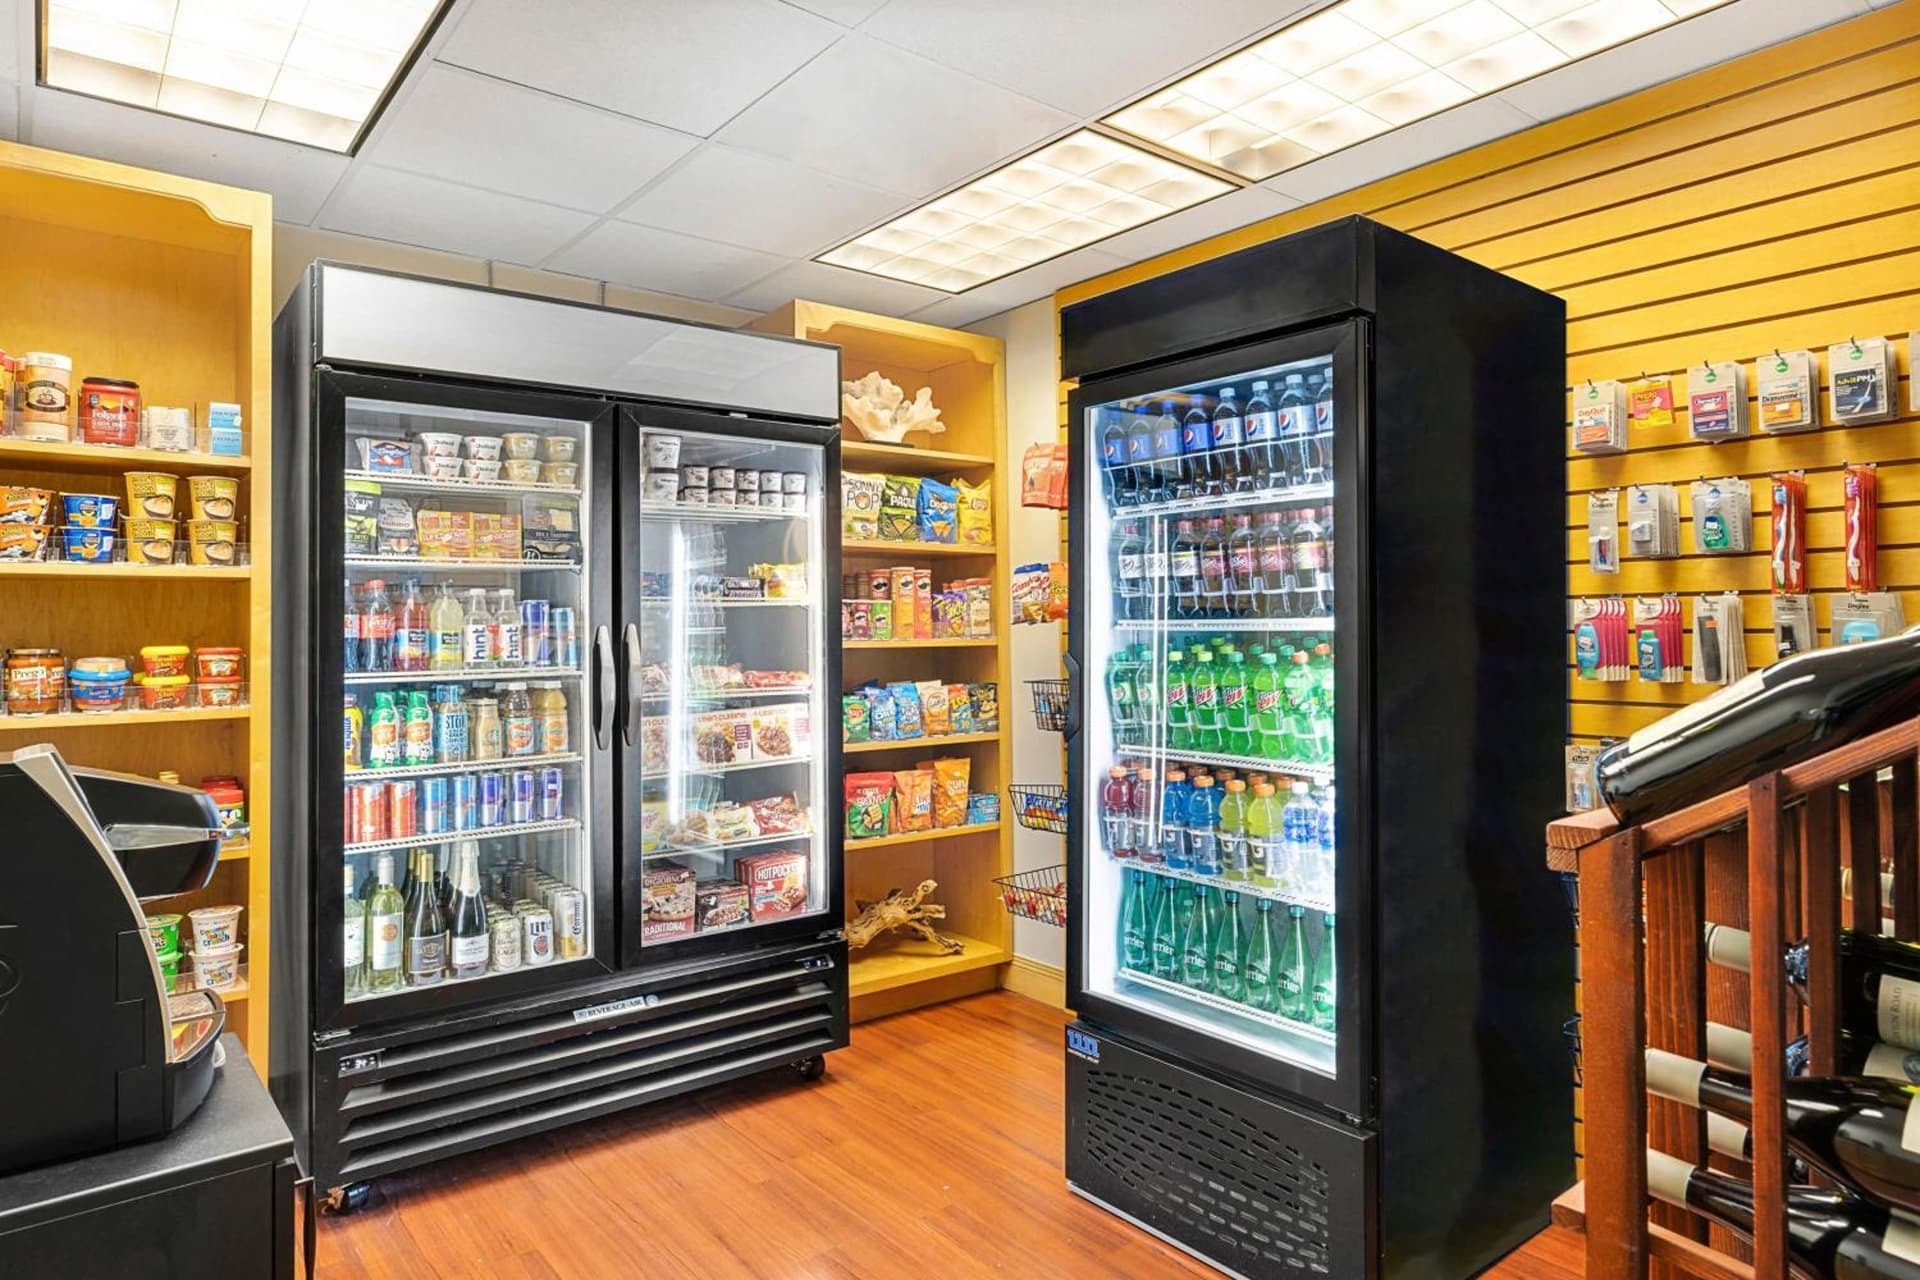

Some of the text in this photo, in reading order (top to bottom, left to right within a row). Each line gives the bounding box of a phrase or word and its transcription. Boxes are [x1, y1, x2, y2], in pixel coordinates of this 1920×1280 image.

[847, 490, 880, 510] POP
[473, 627, 486, 660] hint
[507, 626, 519, 660] hint
[13, 669, 45, 679] Prego
[644, 921, 686, 937] RADITIONAL
